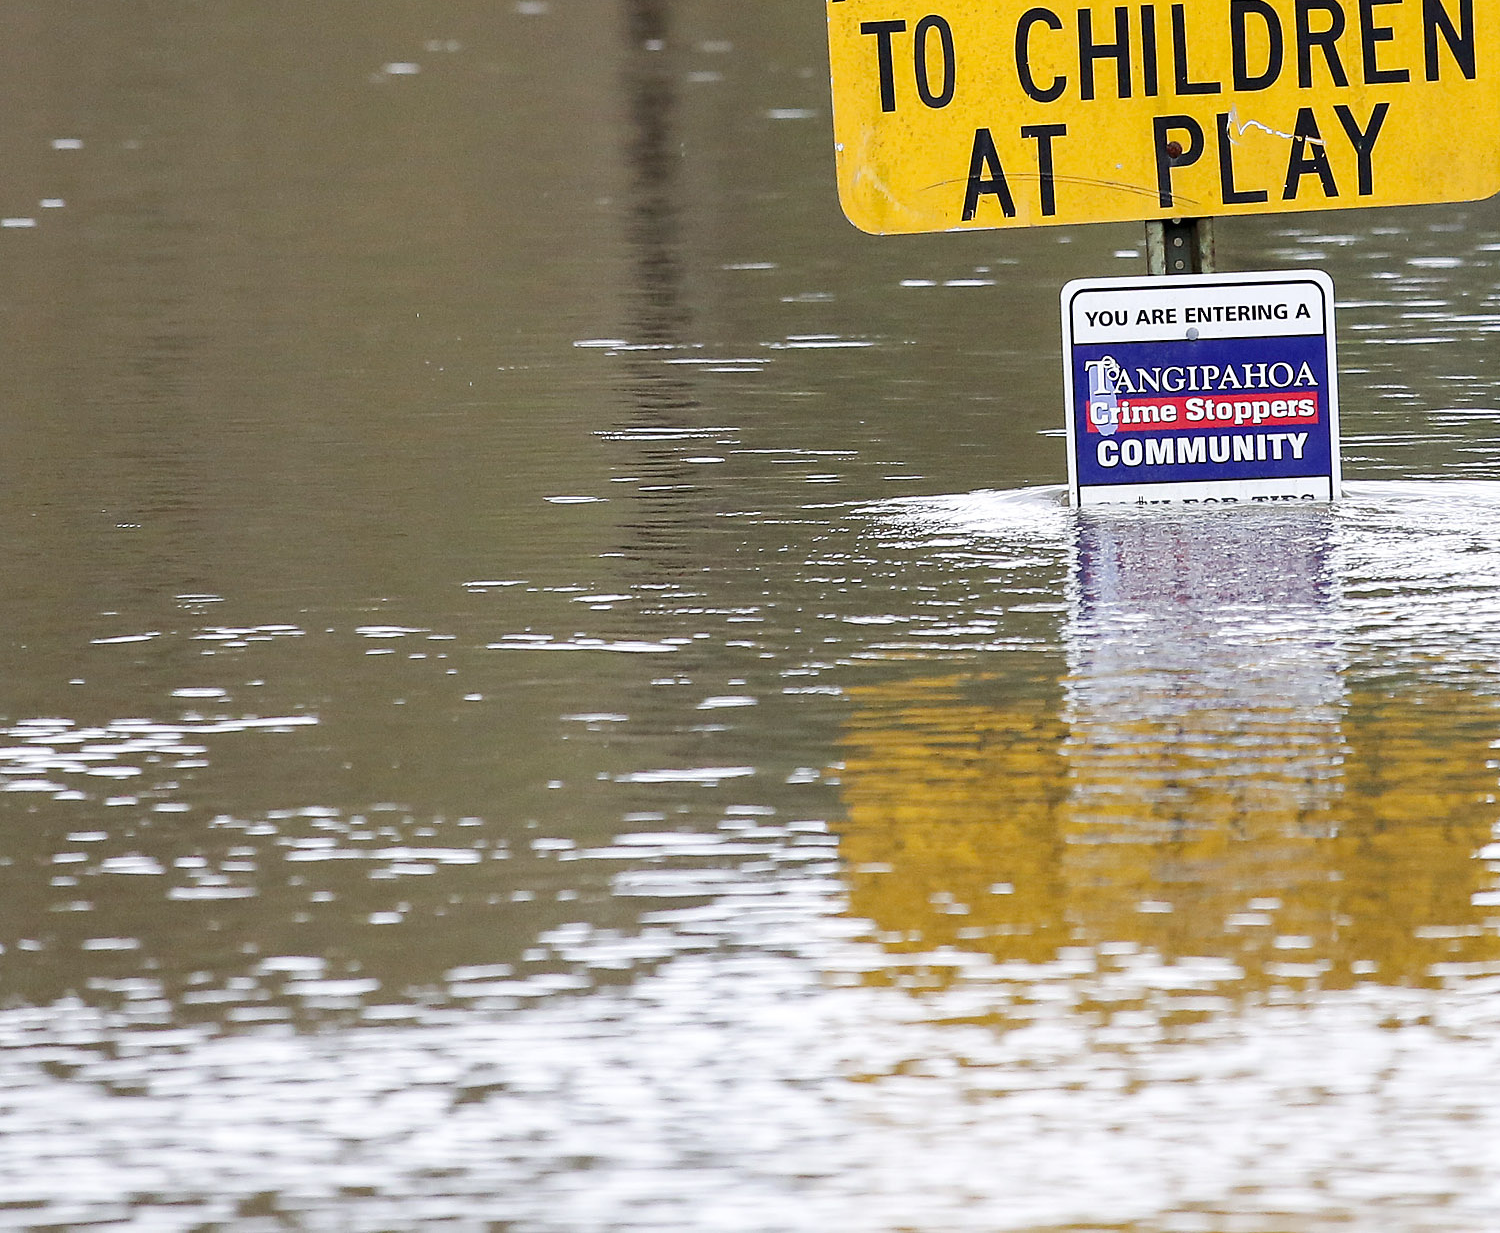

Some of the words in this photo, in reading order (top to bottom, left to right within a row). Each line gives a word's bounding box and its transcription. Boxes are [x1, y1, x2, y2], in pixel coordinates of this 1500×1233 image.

[861, 14, 956, 113] TO
[960, 124, 1066, 222] AT
[1152, 102, 1390, 208] PLAY
[1085, 310, 1128, 327] YOU
[1136, 309, 1177, 325] ARE
[1185, 304, 1288, 323] ENTERING
[1295, 303, 1311, 319] A
[1085, 356, 1319, 395] TANGIPAHOA
[1089, 401, 1177, 426] Crime
[1185, 397, 1315, 425] Stoppers
[1096, 432, 1309, 467] COMMUNITY
